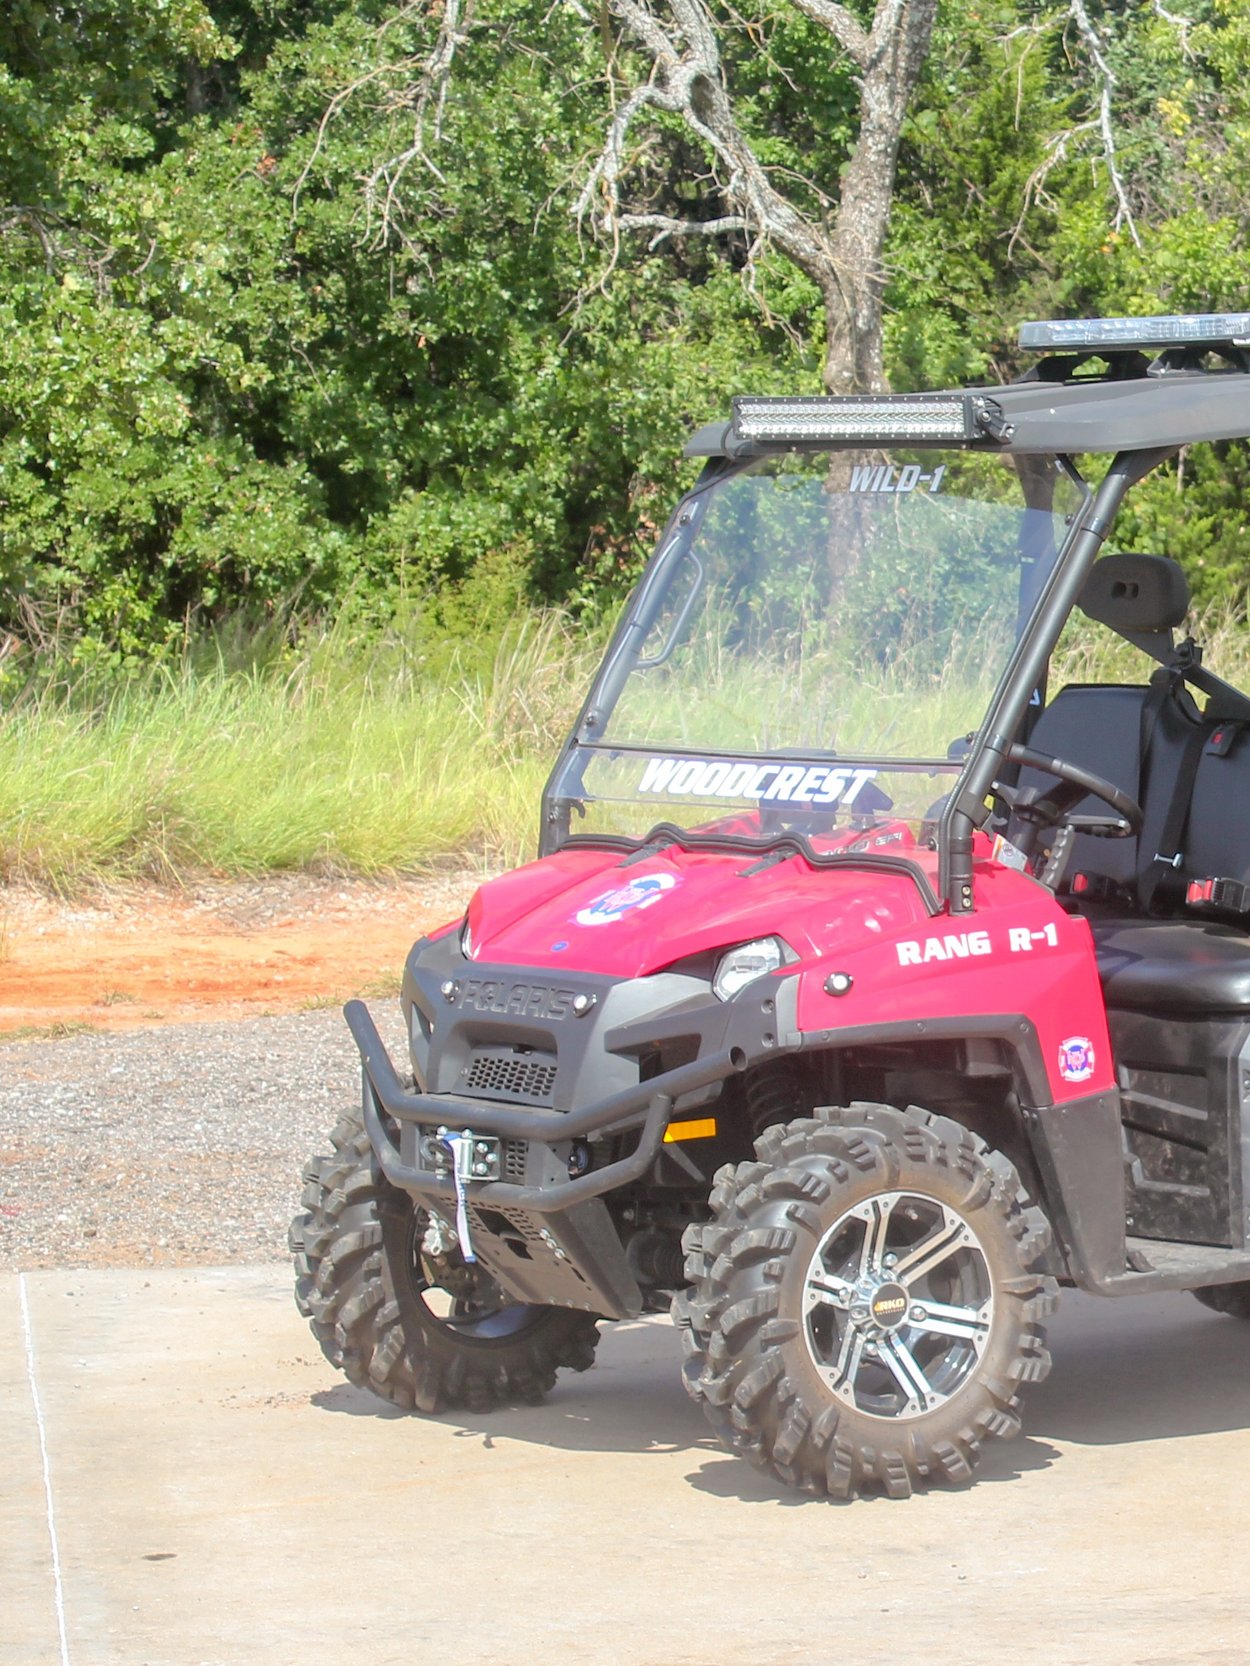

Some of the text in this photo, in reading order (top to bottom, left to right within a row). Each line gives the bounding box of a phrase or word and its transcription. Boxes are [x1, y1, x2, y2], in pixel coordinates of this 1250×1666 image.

[849, 465, 946, 492] WILD-1
[638, 758, 877, 804] WOODCREST
[896, 922, 1058, 966] RANG R-1
[458, 979, 575, 1020] POLARIS
